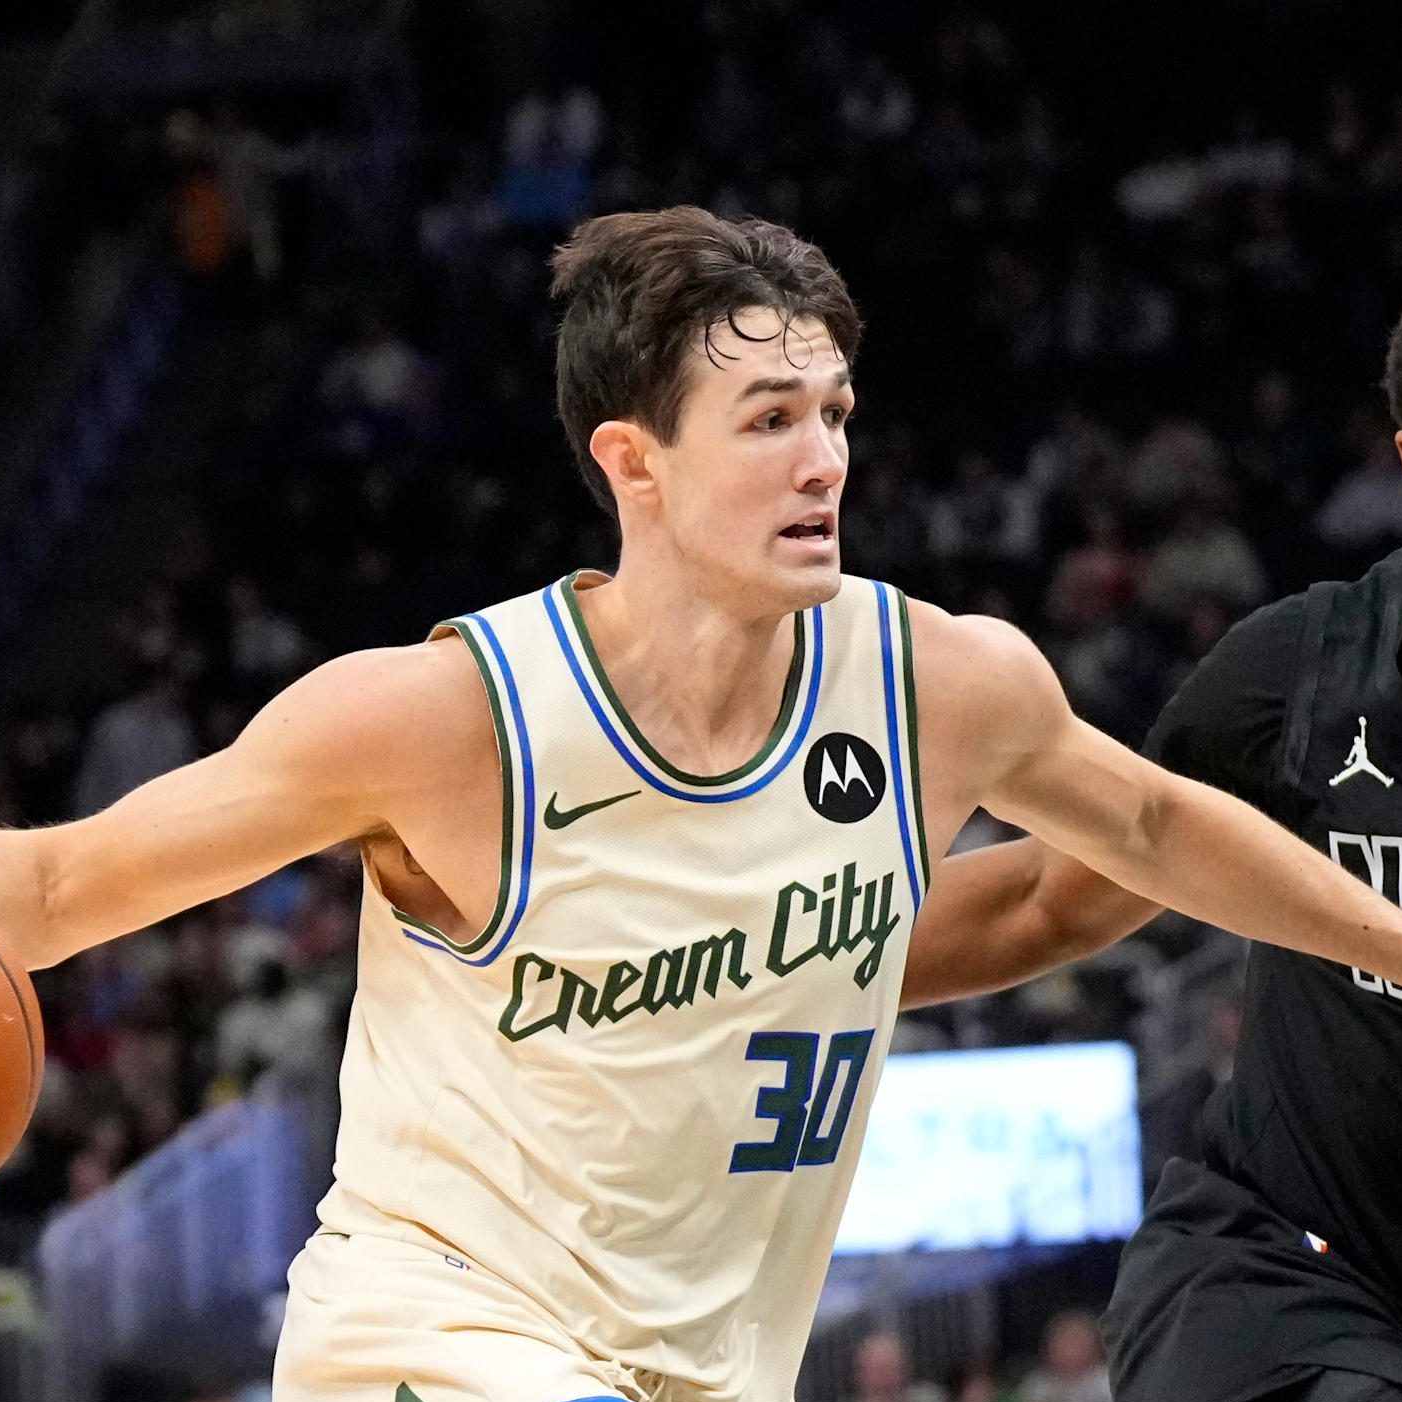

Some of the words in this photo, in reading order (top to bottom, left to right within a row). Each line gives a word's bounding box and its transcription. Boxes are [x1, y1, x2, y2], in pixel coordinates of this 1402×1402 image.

[498, 928, 753, 1043] Cream
[765, 861, 901, 991] City
[728, 1028, 876, 1174] 30
